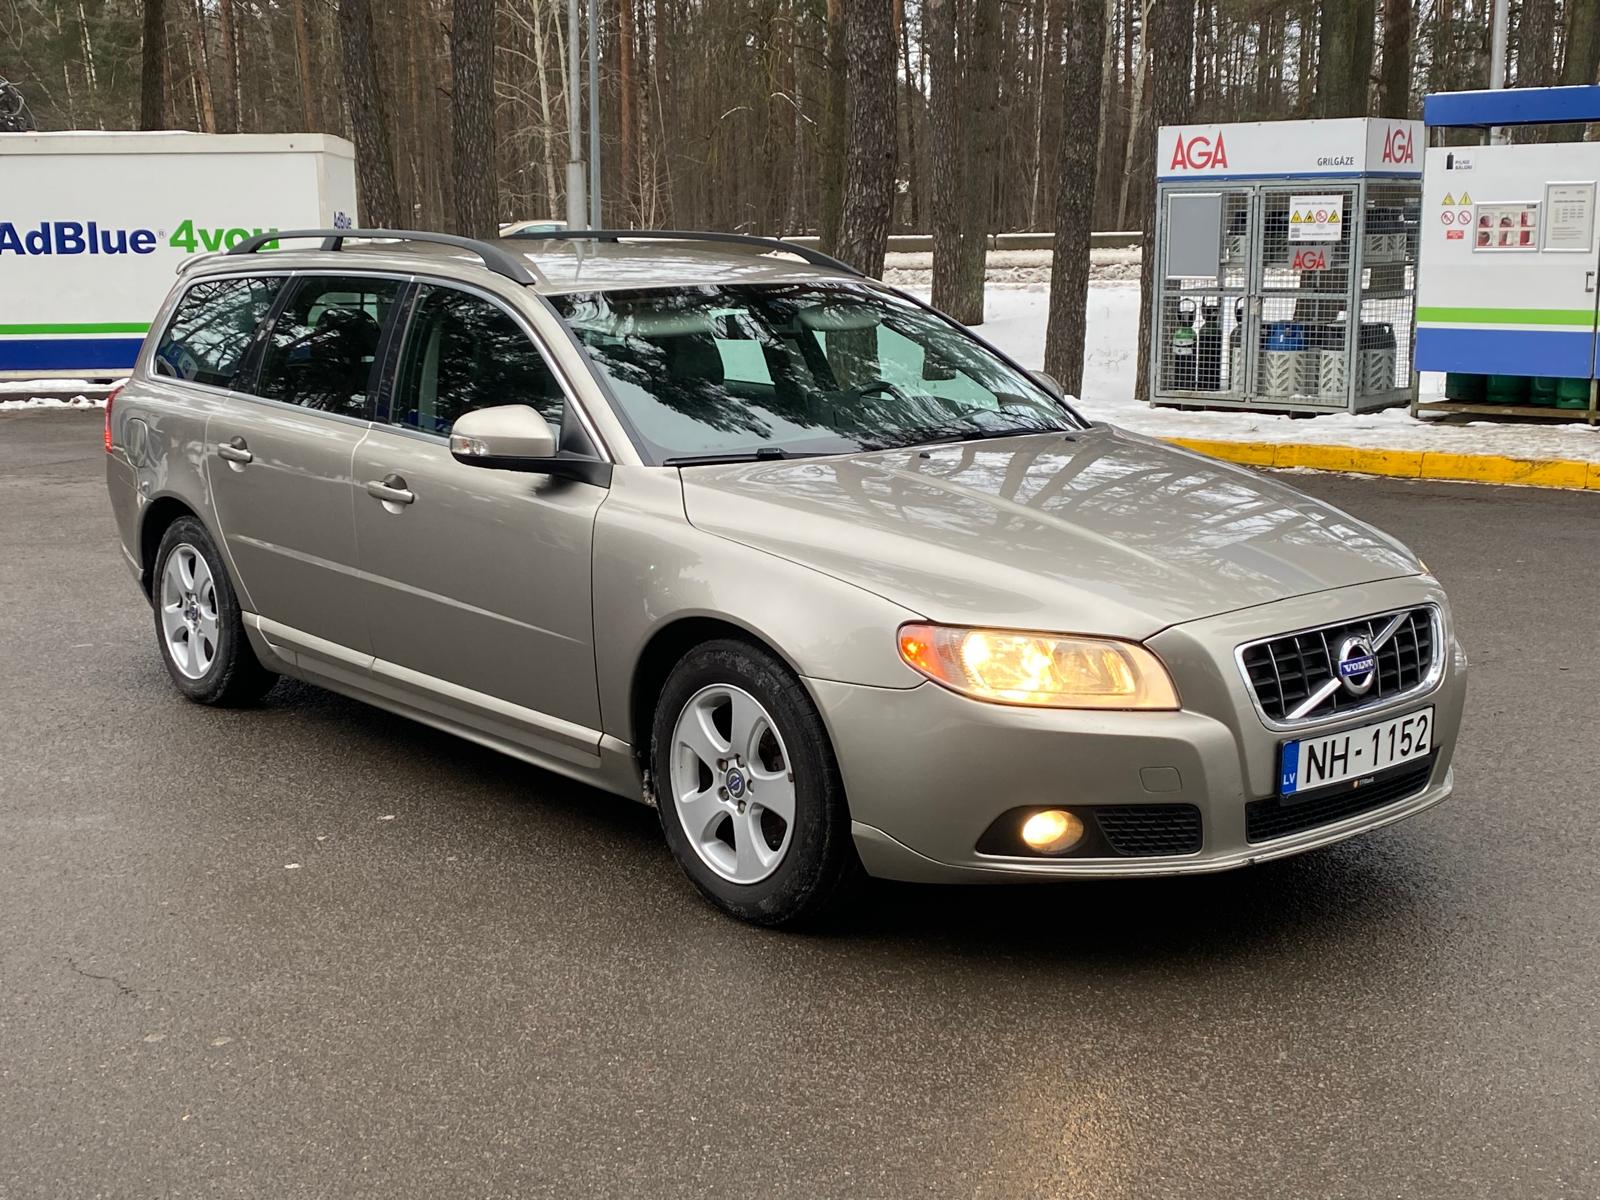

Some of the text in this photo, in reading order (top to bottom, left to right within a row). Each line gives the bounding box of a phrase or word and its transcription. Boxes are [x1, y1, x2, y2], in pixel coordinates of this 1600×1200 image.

[1170, 130, 1229, 170] AGA
[1382, 124, 1414, 164] AGA
[1292, 247, 1327, 270] AGA
[1342, 658, 1374, 673] VOLVO
[1305, 714, 1429, 784] NH-1152
[1283, 772, 1297, 786] LV
